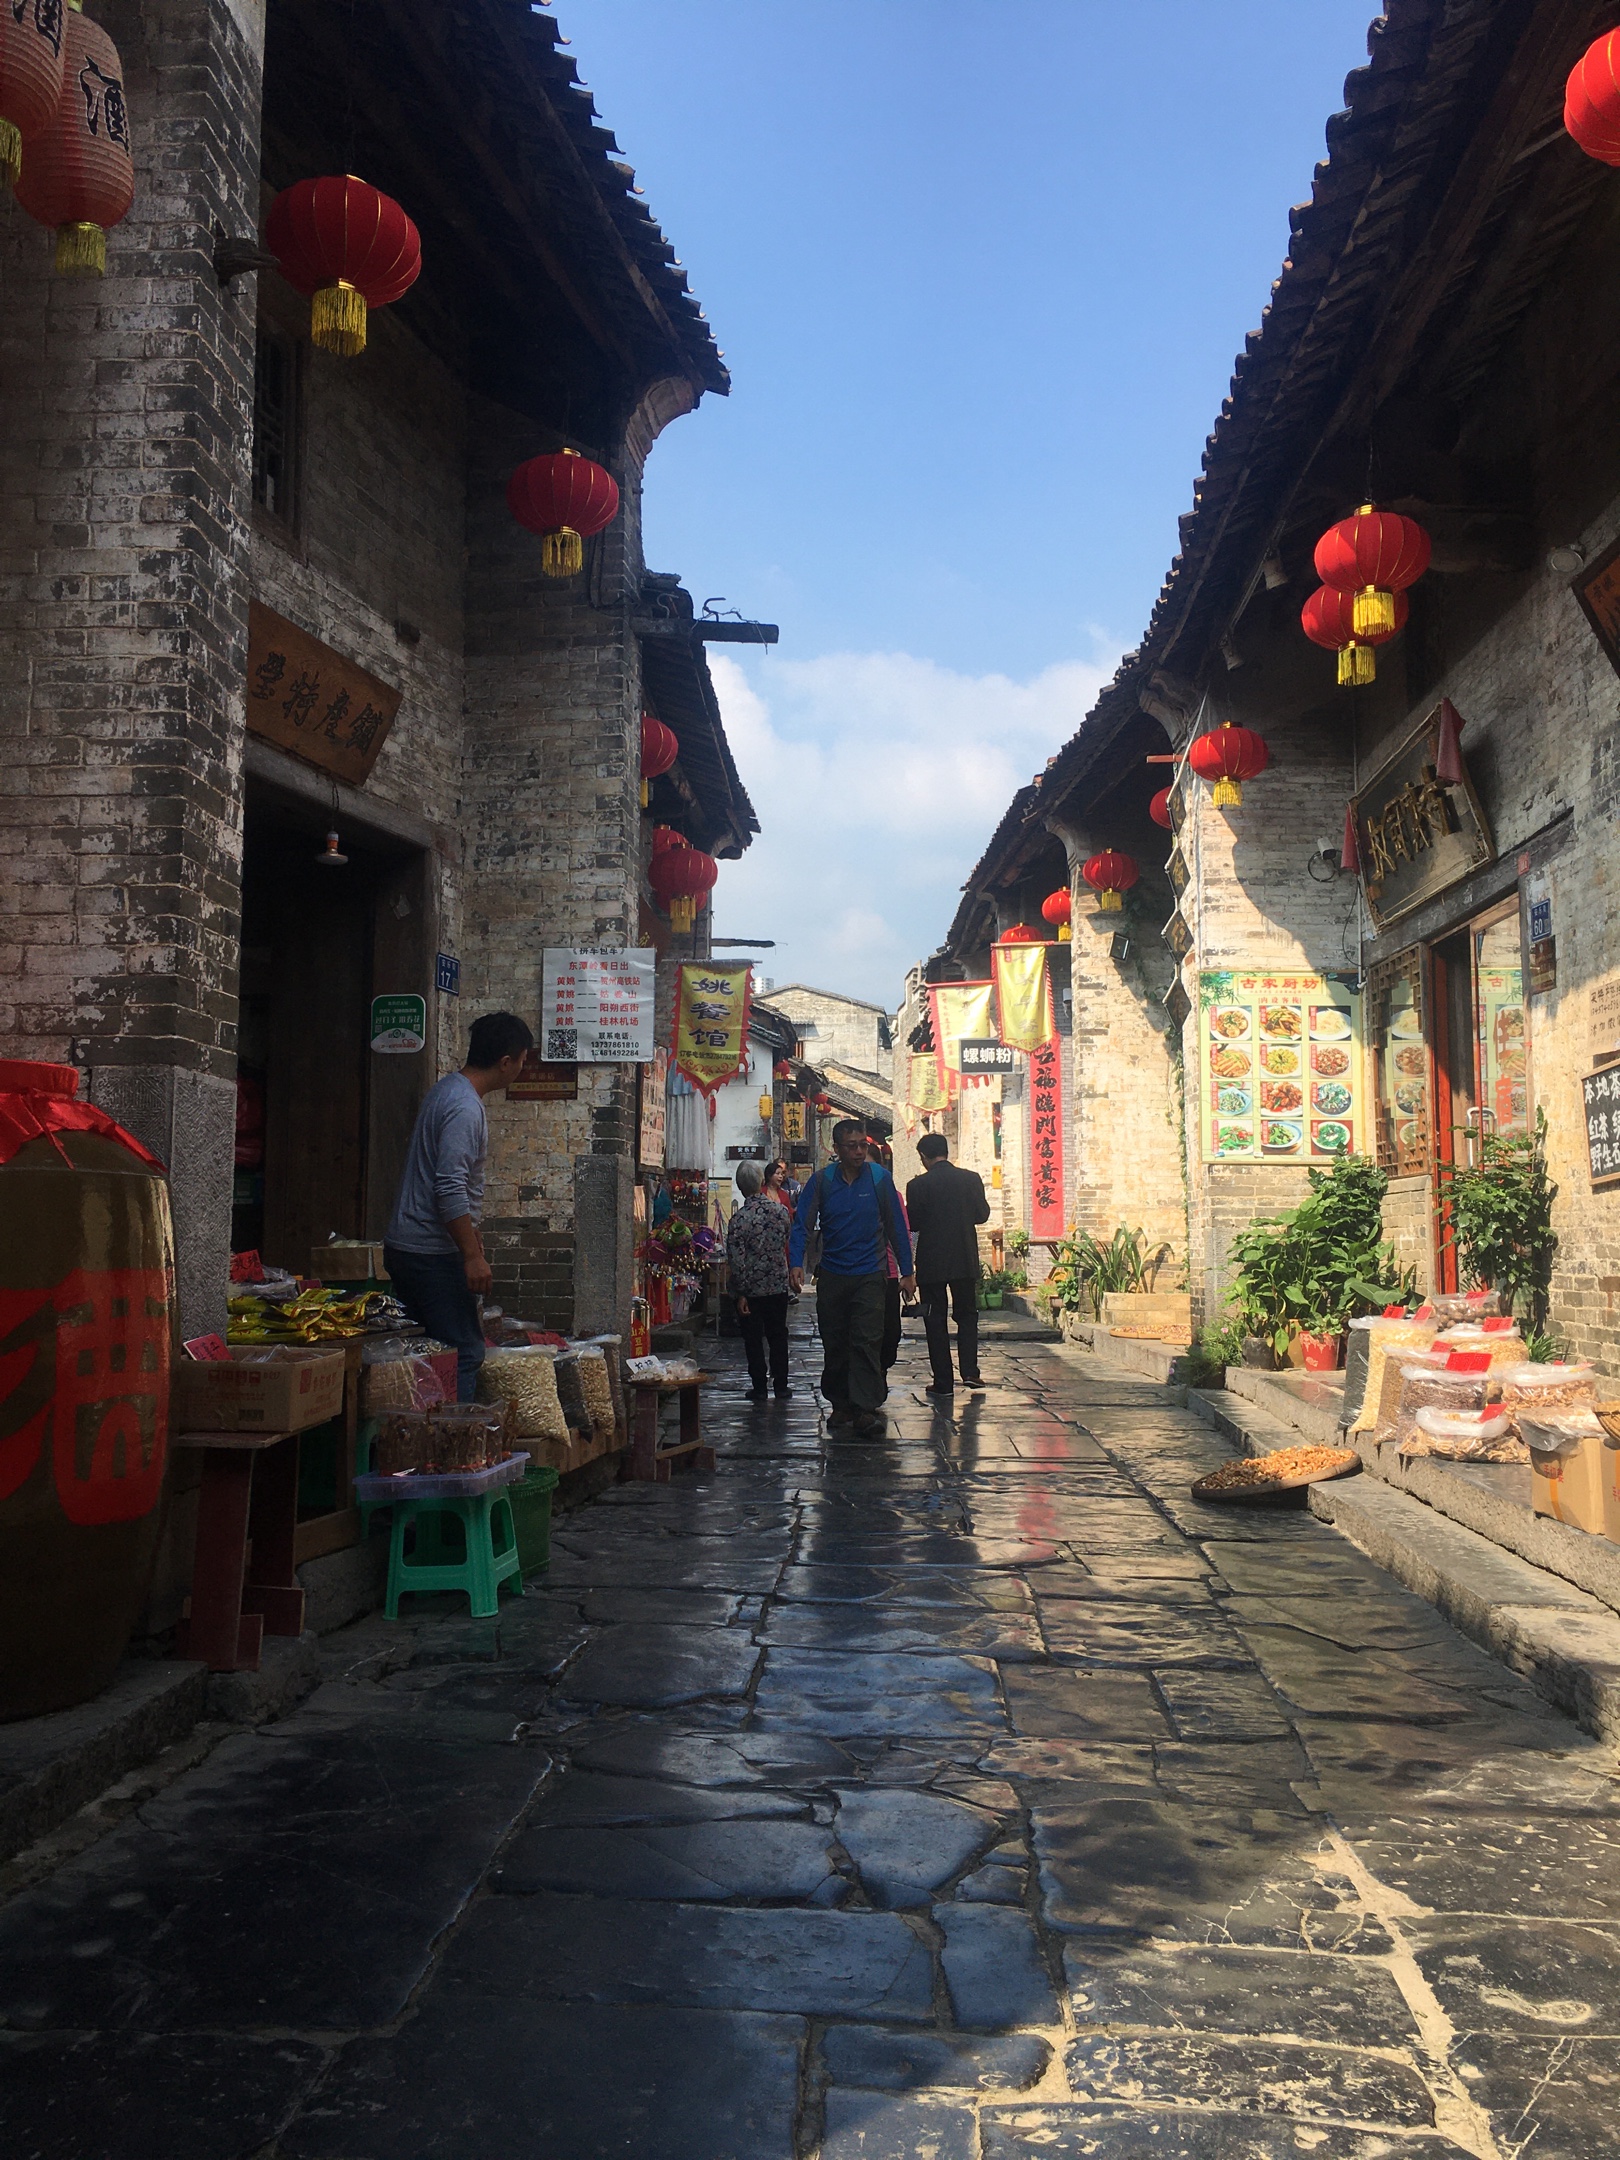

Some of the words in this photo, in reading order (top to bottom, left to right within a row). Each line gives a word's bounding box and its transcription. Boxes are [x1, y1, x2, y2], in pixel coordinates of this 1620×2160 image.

[78, 54, 131, 156] 酒
[1533, 918, 1544, 936] 60
[568, 960, 630, 971] 东潭岭看日出
[440, 970, 452, 988] 17
[1239, 976, 1321, 990] 古家厨坊
[590, 1041, 640, 1049] 13737861810
[962, 1046, 1012, 1064] 螺蛳粉
